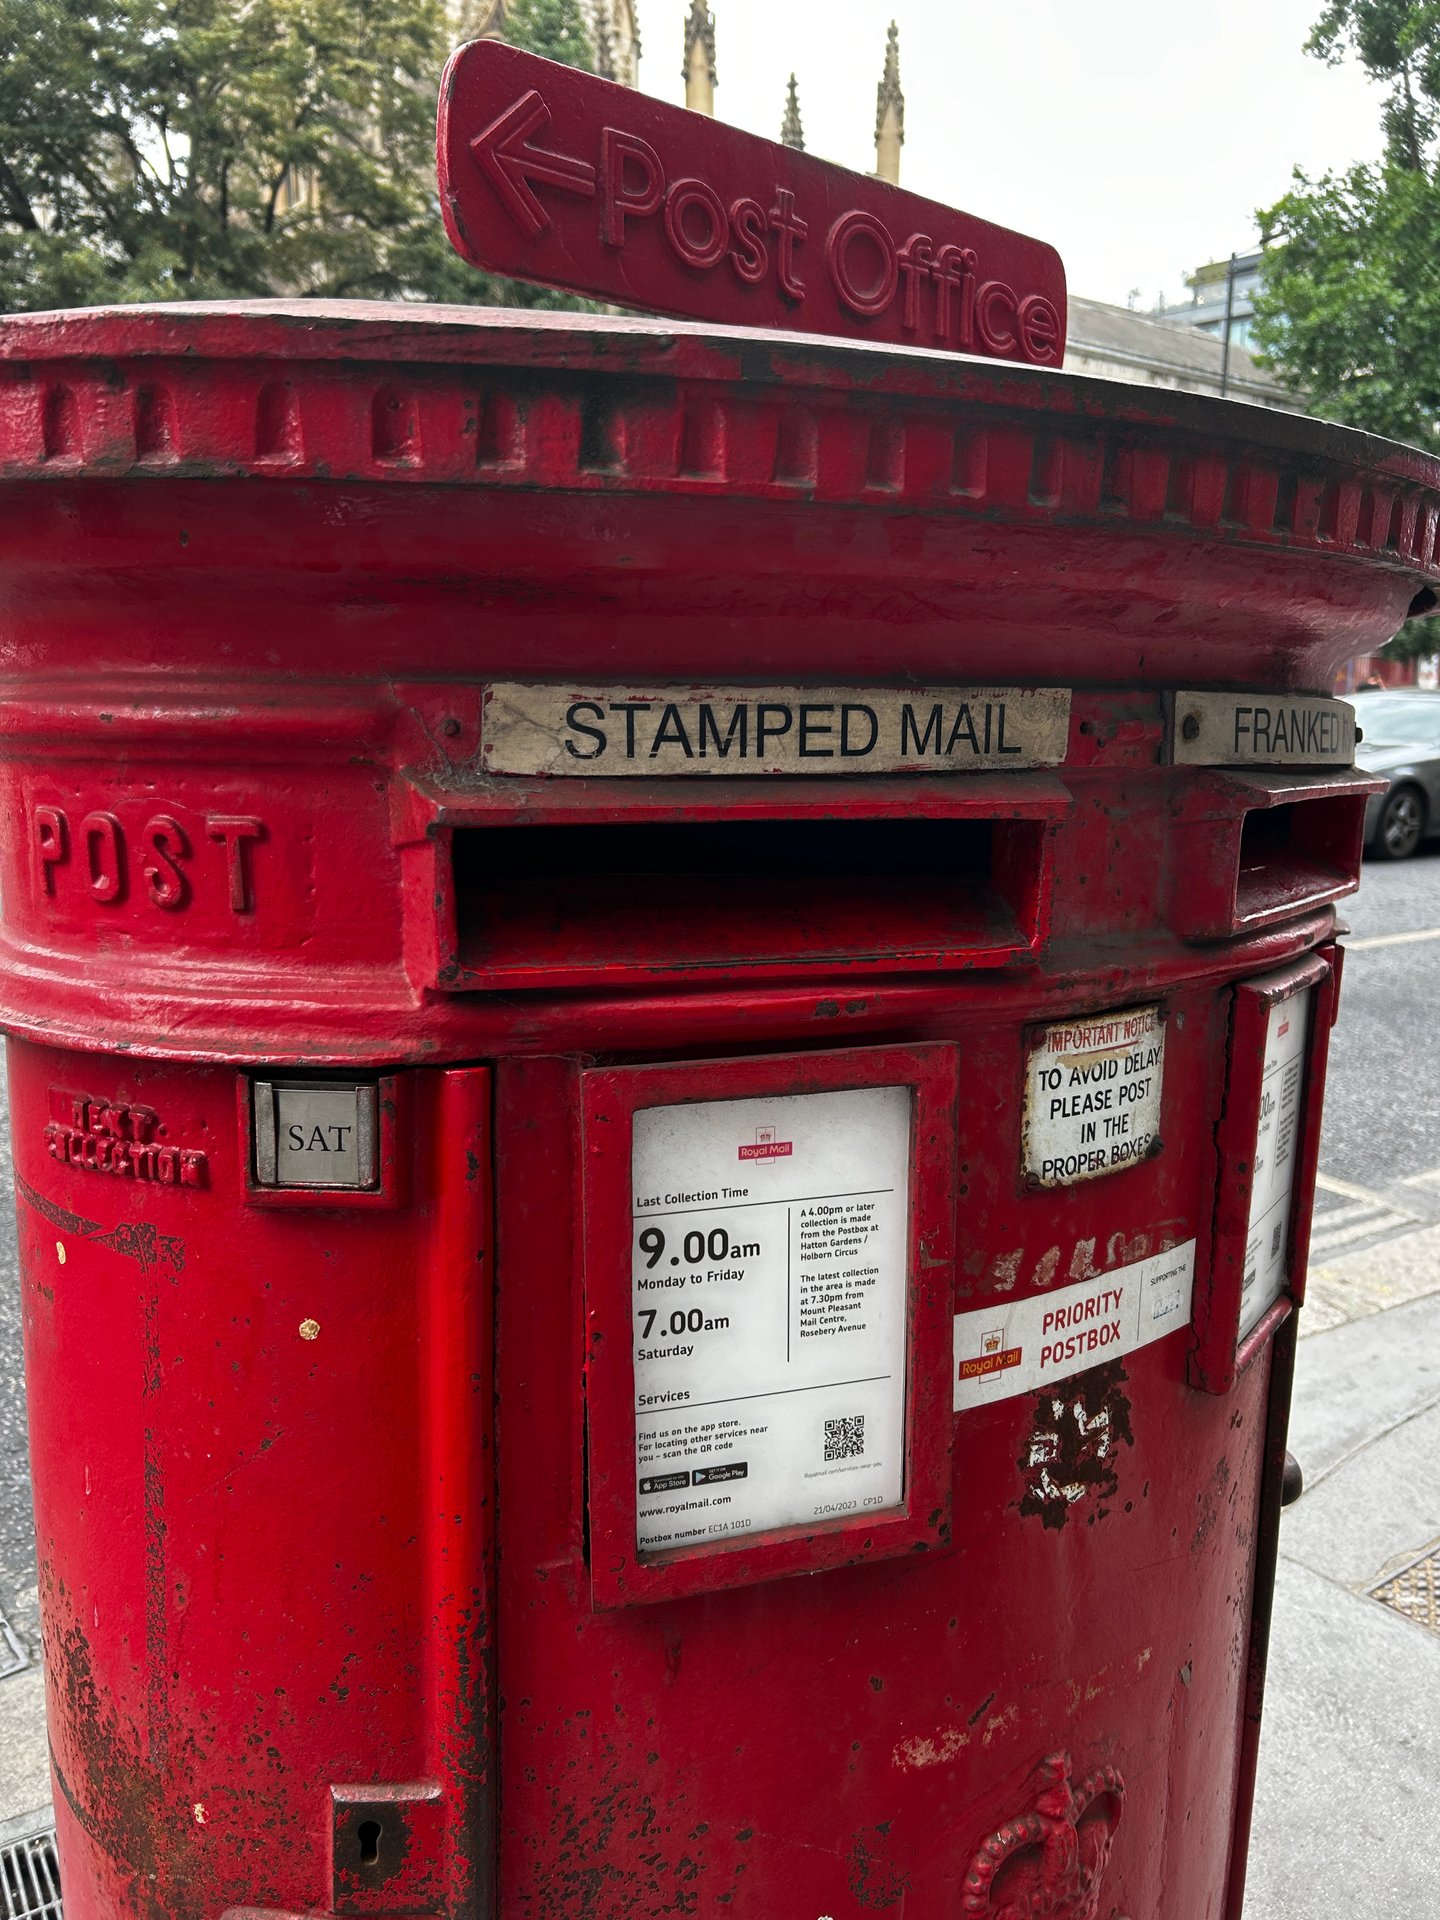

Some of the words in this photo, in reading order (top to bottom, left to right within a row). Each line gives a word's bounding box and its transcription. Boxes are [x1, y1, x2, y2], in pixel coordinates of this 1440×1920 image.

[601, 127, 807, 301] Post
[829, 210, 1062, 361] Office
[564, 702, 879, 760] STAMPED
[901, 703, 1021, 756] MAIL
[1235, 708, 1339, 753] FRANKED
[34, 806, 264, 913] POST
[1048, 1021, 1122, 1053] IMPORTANT
[1124, 1013, 1154, 1040] NOTICE
[1039, 1068, 1062, 1091] TO
[1069, 1060, 1117, 1087] AVOID
[1125, 1045, 1163, 1074] DELAY
[1050, 1089, 1112, 1120] PLEASE
[1119, 1078, 1151, 1106] POST
[288, 1124, 351, 1152] SAT
[1081, 1122, 1096, 1143] IN
[1103, 1113, 1128, 1138] THE
[741, 1147, 767, 1158] Royal
[770, 1144, 789, 1154] Mail
[1042, 1149, 1105, 1179] PROPER
[1111, 1133, 1150, 1165] BOXES
[637, 1196, 661, 1207] Last
[665, 1190, 718, 1204] Collection
[722, 1188, 748, 1198] Time
[801, 1209, 806, 1217] A
[809, 1206, 843, 1216] 4.00pm
[857, 1203, 875, 1211] later
[801, 1217, 838, 1228] collection
[841, 1216, 847, 1224] is
[850, 1214, 871, 1223] made
[801, 1231, 819, 1239] from
[823, 1229, 835, 1237] the
[838, 1225, 868, 1235] Postbox
[871, 1224, 878, 1232] at
[639, 1228, 760, 1269] 9.00am
[801, 1240, 827, 1250] Hatton
[830, 1237, 862, 1247] Gardens
[864, 1235, 868, 1243] /
[801, 1251, 832, 1261] Holborn
[835, 1248, 858, 1257] Circus
[638, 1277, 686, 1290] Monday
[691, 1274, 702, 1284] to
[707, 1270, 744, 1282] Friday
[800, 1274, 815, 1283] The
[818, 1271, 840, 1281] latest
[843, 1267, 879, 1278] collection
[1151, 1268, 1177, 1286] SUPPORTING
[811, 1284, 827, 1293] the
[826, 1282, 843, 1291] area
[855, 1278, 876, 1287] made
[811, 1293, 842, 1304] 7.30pm
[845, 1291, 864, 1299] from
[801, 1307, 825, 1316] Mount
[828, 1302, 861, 1313] Pleasant
[1042, 1287, 1123, 1335] PRIORITY
[638, 1308, 729, 1339] 7.00am
[801, 1318, 816, 1327] Mail
[801, 1327, 836, 1337] Rosebery
[838, 1323, 866, 1332] Avenue
[638, 1344, 694, 1361] Saturday
[1040, 1320, 1121, 1368] POSTBOX
[962, 1357, 994, 1376] Royal
[995, 1351, 1019, 1368] Mail
[638, 1389, 690, 1406] Services
[639, 1432, 656, 1440] Find
[685, 1425, 698, 1433] the
[701, 1424, 715, 1432] app
[718, 1420, 741, 1429] store.
[639, 1444, 652, 1452] For
[655, 1437, 687, 1449] locating
[690, 1434, 712, 1443] other
[715, 1429, 747, 1440] services
[750, 1426, 768, 1434] near
[638, 1455, 653, 1464] you
[663, 1450, 682, 1459] scan
[684, 1447, 698, 1455] the
[714, 1442, 733, 1450] code
[654, 1482, 667, 1490] App
[669, 1479, 686, 1487] Store
[709, 1471, 731, 1480] Google
[639, 1496, 731, 1518] www.royalmail.com
[813, 1501, 857, 1515] 21/04/2023
[863, 1496, 883, 1505] CP1D
[640, 1534, 672, 1545] Postbox
[675, 1528, 705, 1539] number
[708, 1523, 728, 1533] EC1A
[731, 1519, 751, 1529] 101D
